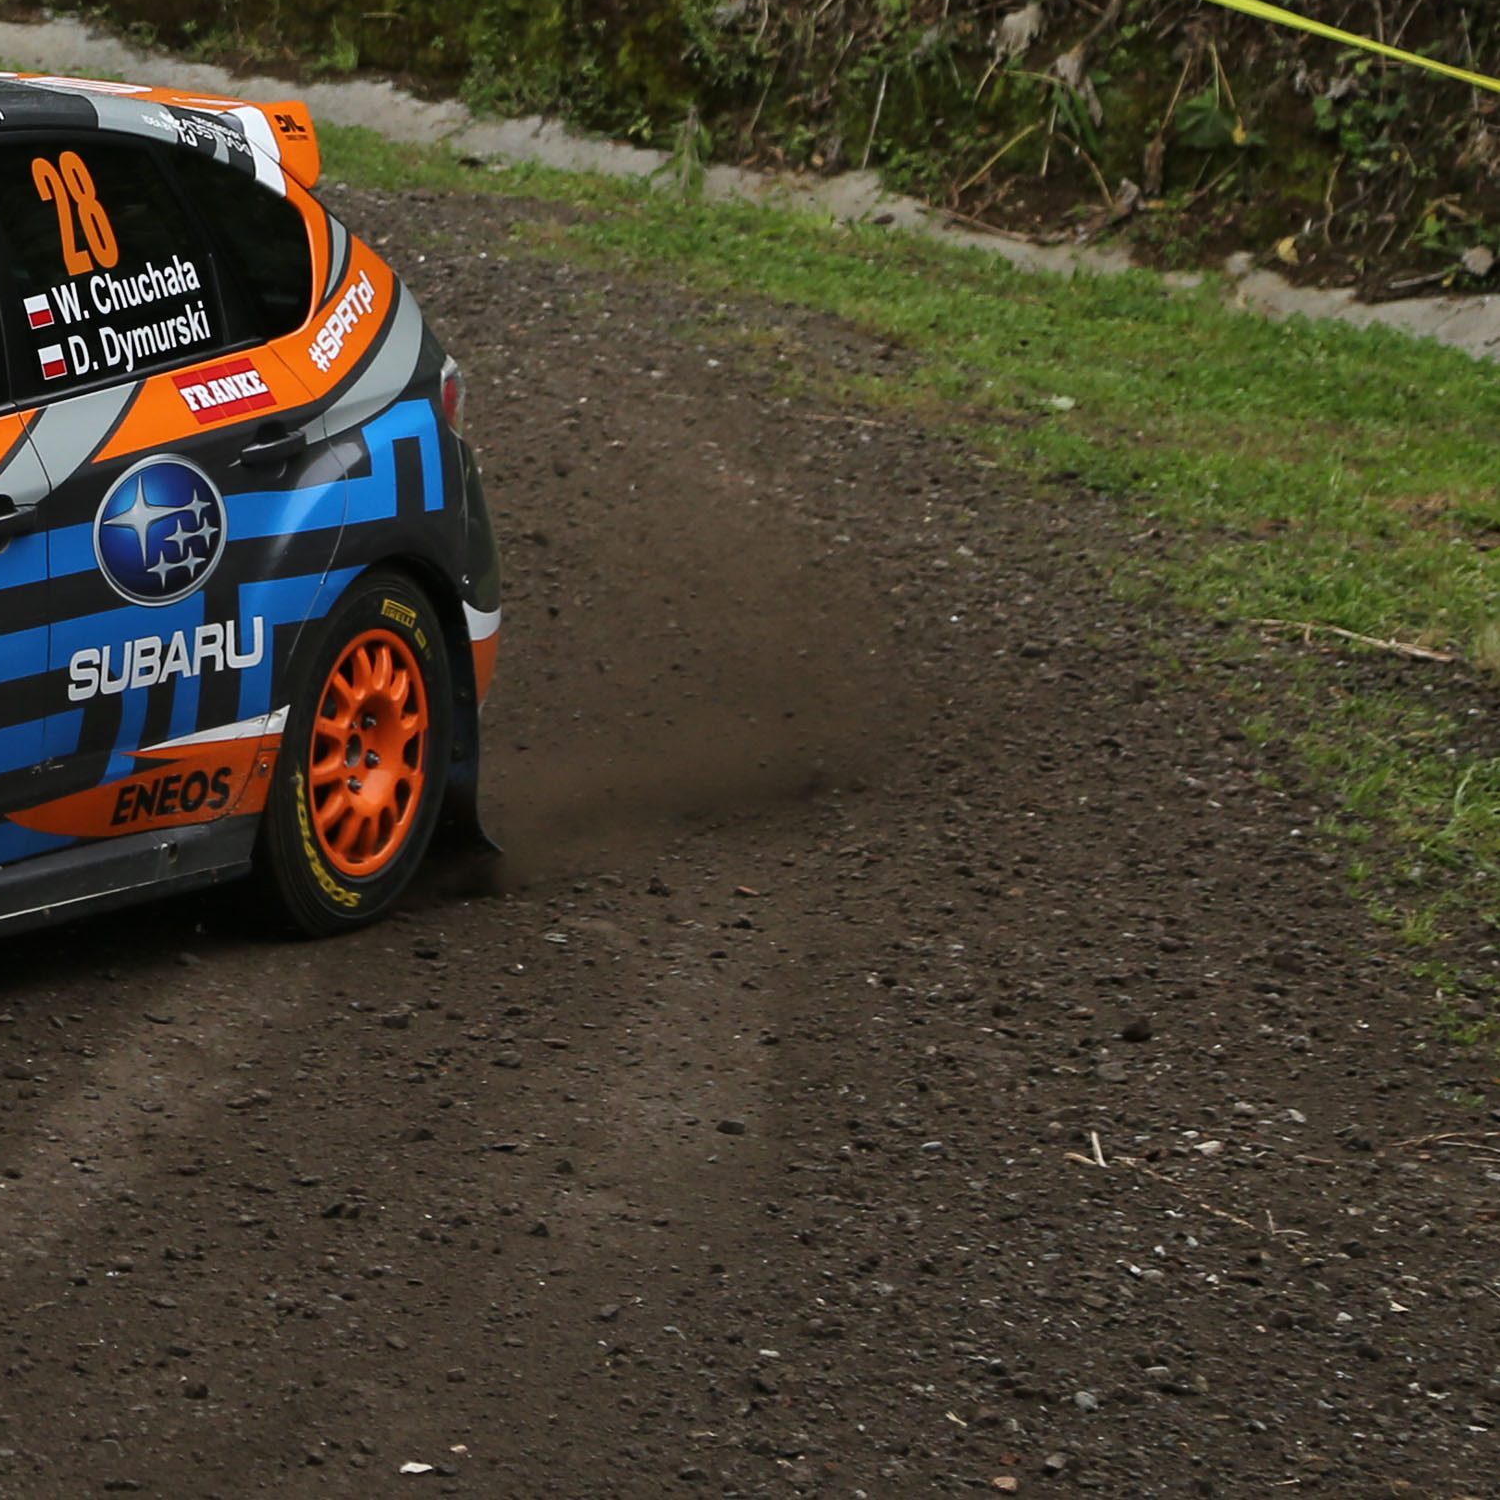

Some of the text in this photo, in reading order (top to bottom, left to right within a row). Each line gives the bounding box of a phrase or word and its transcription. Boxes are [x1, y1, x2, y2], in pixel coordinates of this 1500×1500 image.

[31, 151, 120, 276] 28
[51, 254, 201, 325] W. Chuchała
[308, 270, 376, 373] #SPRTpl
[67, 300, 212, 376] D. Dymurski
[179, 369, 270, 412] FRANKE
[67, 615, 265, 702] SUBARU
[110, 767, 233, 827] ENEOS
